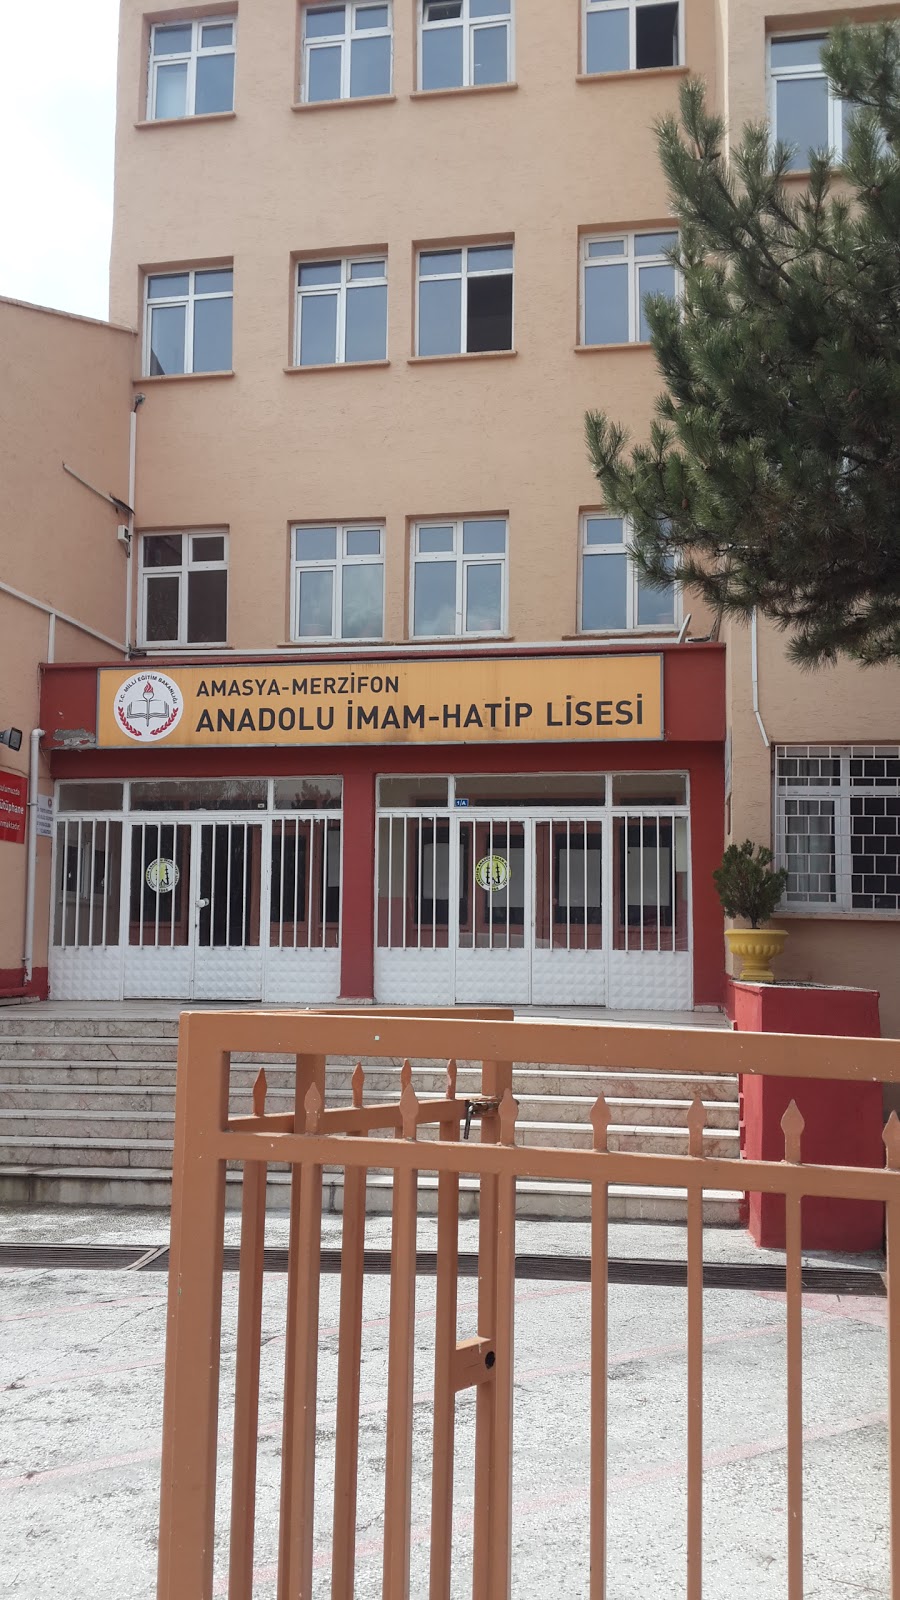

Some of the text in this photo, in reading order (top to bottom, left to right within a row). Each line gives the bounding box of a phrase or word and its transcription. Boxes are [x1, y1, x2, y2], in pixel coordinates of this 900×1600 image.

[123, 679, 137, 693] MİLLİ
[137, 674, 158, 682] EĞİTİM
[157, 677, 178, 704] BAKANLIĞI
[196, 673, 399, 698] AMASYA-MERZİFON
[195, 693, 643, 733] ANADOLU İMAM-HATİP LİSESİ
